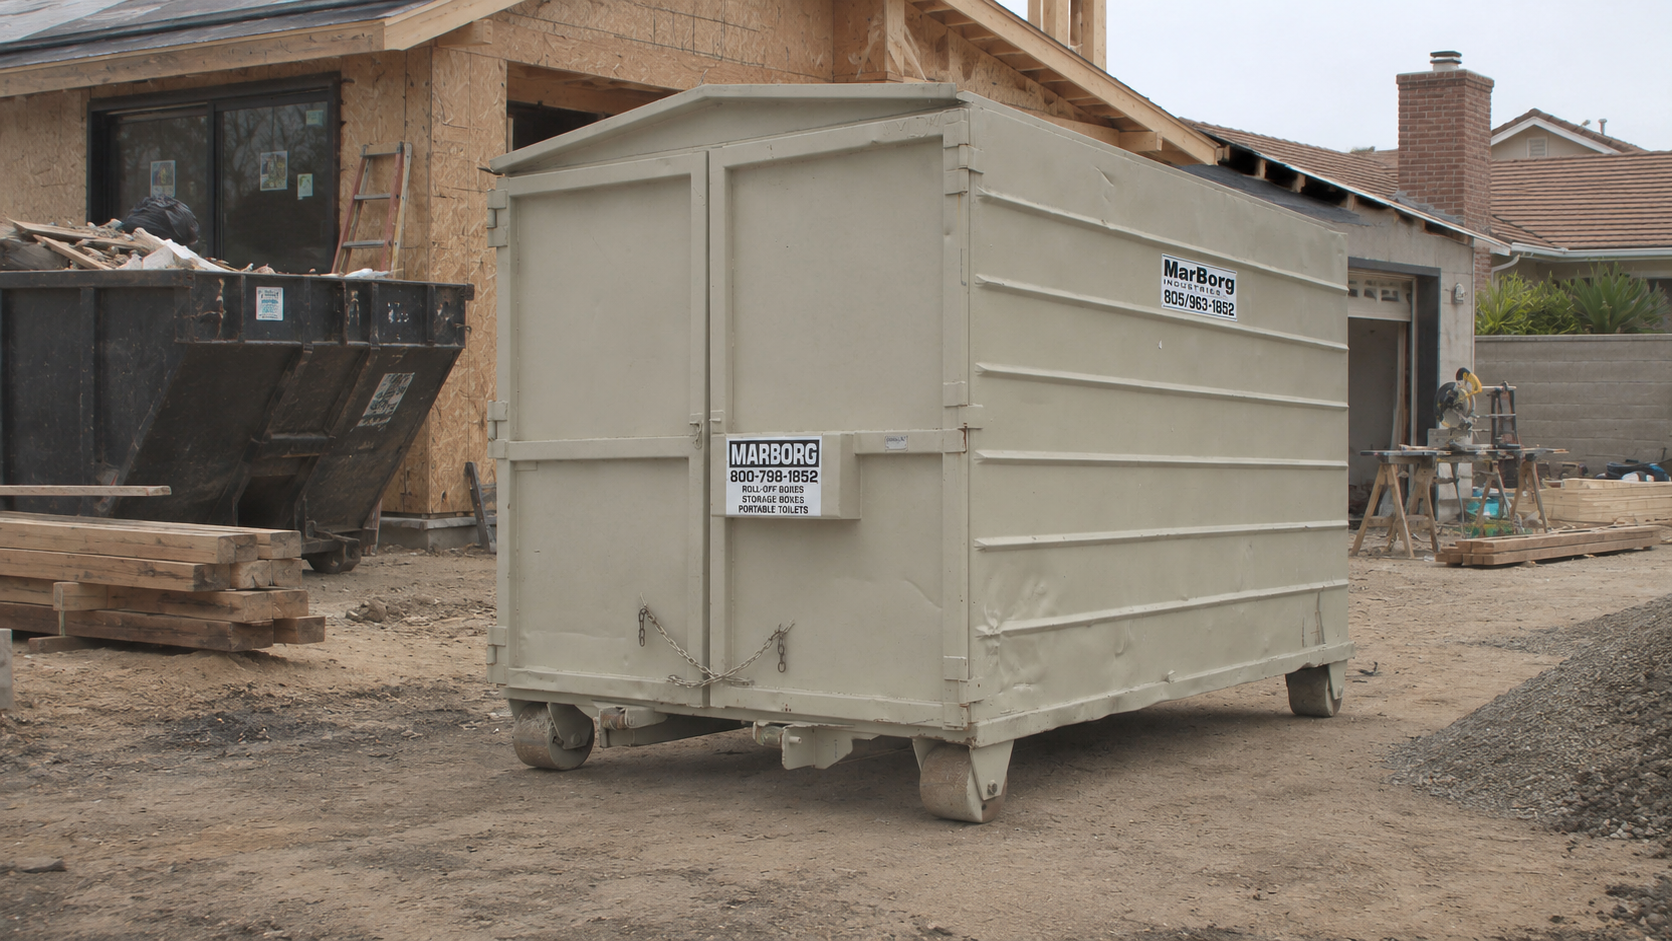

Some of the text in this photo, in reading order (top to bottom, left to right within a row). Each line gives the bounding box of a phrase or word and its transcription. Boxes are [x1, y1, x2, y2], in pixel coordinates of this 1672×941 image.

[1164, 259, 1235, 295] MarBorg
[731, 443, 818, 465] MARBORG
[730, 470, 818, 483] 800-798-1852
[742, 485, 777, 493] ROLL-OFF
[742, 495, 804, 504] STORAGE BOXES
[738, 505, 809, 514] PORTABLE TOILETS
